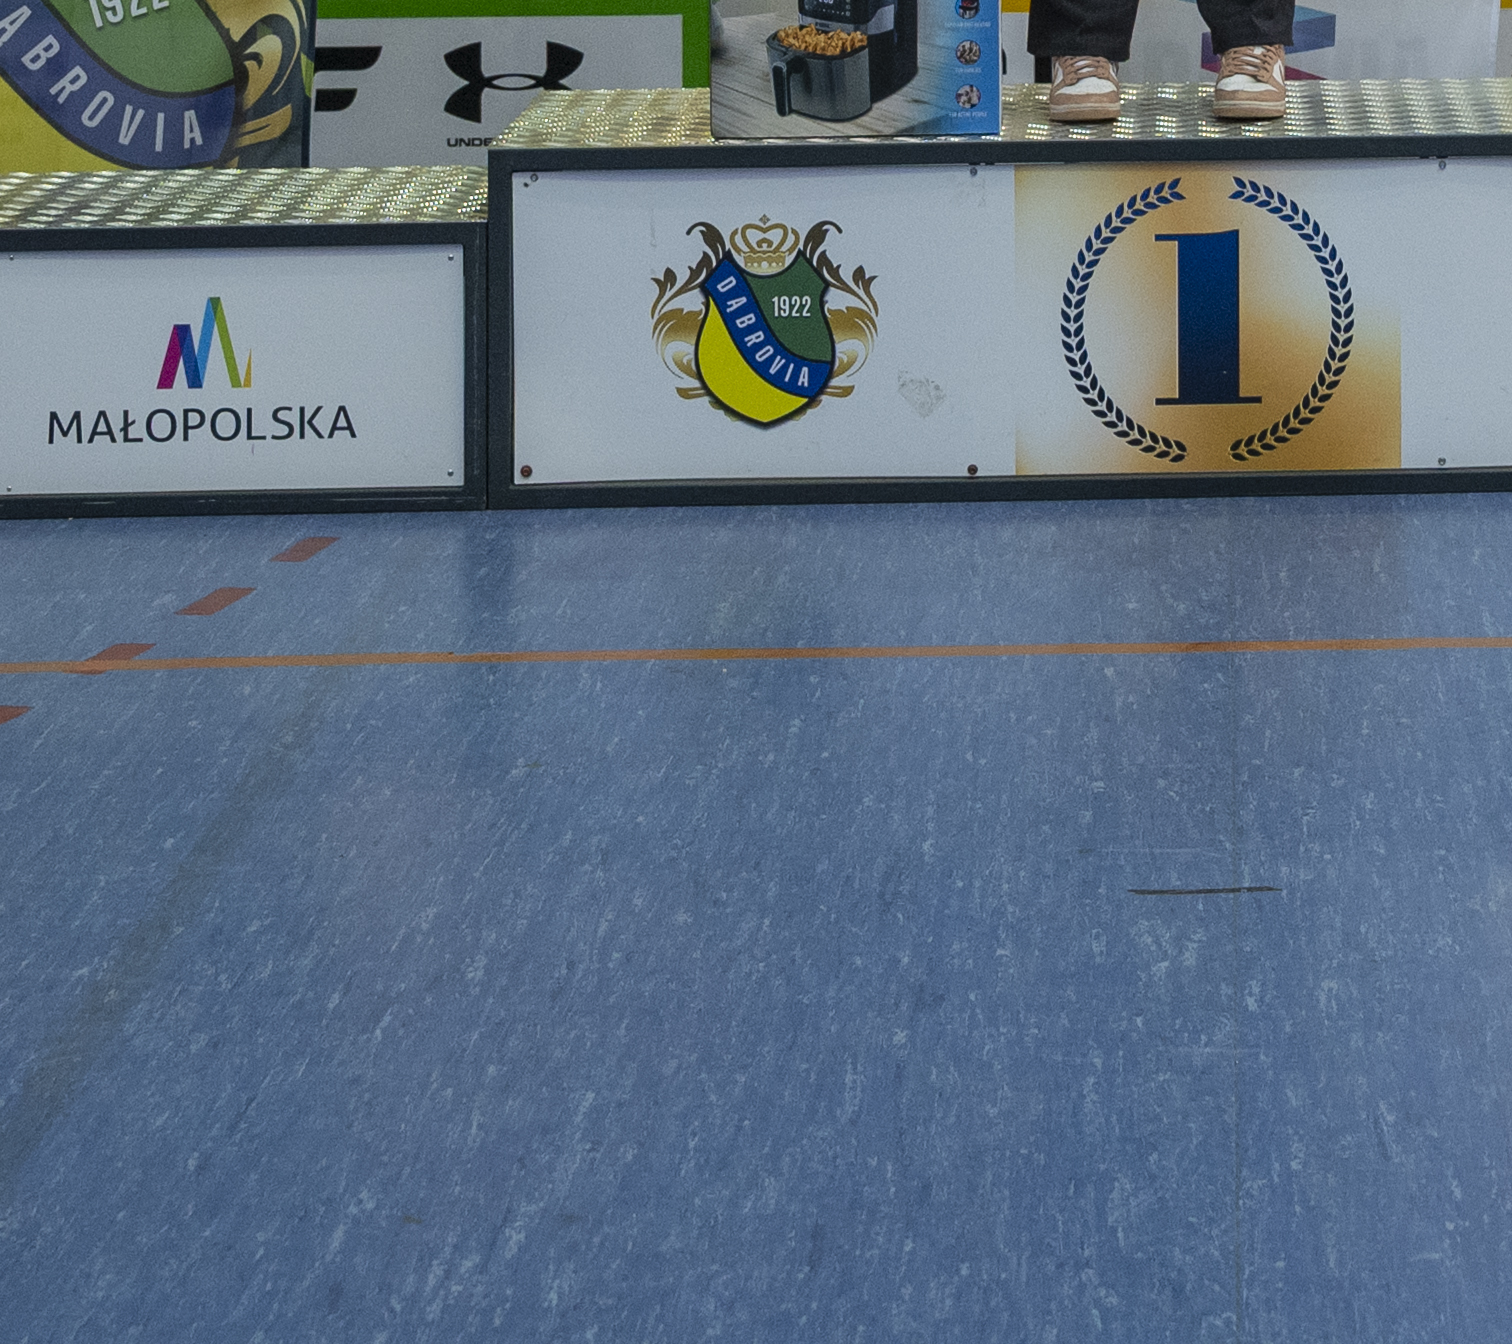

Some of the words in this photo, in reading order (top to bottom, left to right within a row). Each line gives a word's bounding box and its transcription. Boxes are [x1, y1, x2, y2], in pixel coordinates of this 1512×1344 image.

[717, 270, 815, 389] DĄBROVIA
[770, 294, 813, 319] 1922
[1153, 226, 1264, 407] 1
[45, 404, 357, 447] MAŁOPOLSKA
